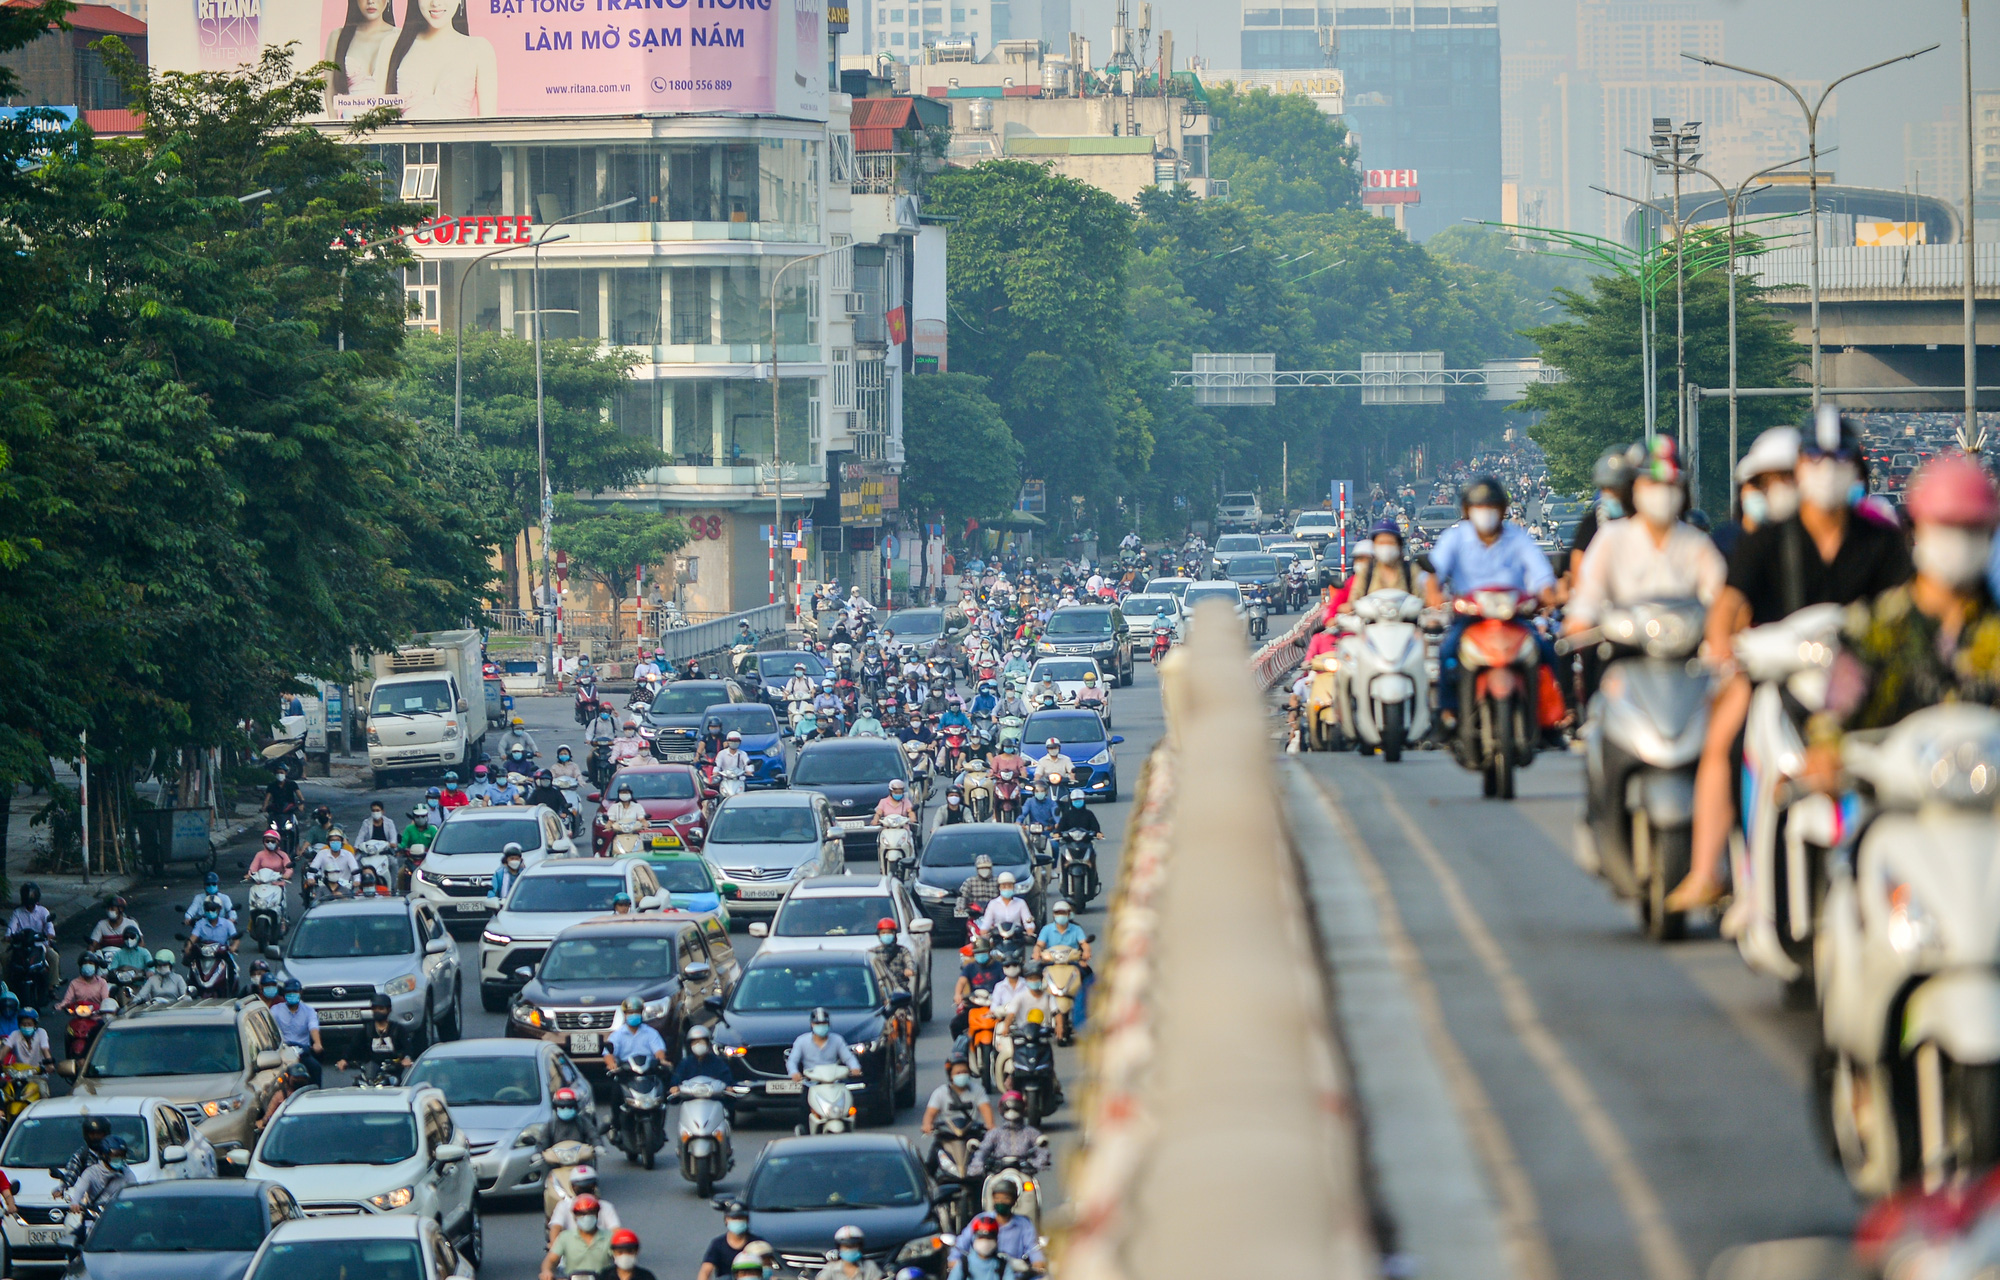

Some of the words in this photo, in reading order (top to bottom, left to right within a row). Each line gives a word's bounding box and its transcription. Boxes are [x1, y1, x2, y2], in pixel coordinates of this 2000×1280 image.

[201, 16, 260, 46] SKIN
[525, 25, 573, 51] LÀM
[581, 23, 620, 50] MỜ
[628, 27, 682, 53] SẠM
[691, 21, 745, 47] NÁM
[545, 83, 631, 94] www.ritana.com.vn
[668, 79, 693, 91] 1800
[695, 79, 713, 91] 556
[714, 79, 732, 91] 889
[1276, 79, 1340, 94] LAND
[412, 215, 532, 245] COFFEE
